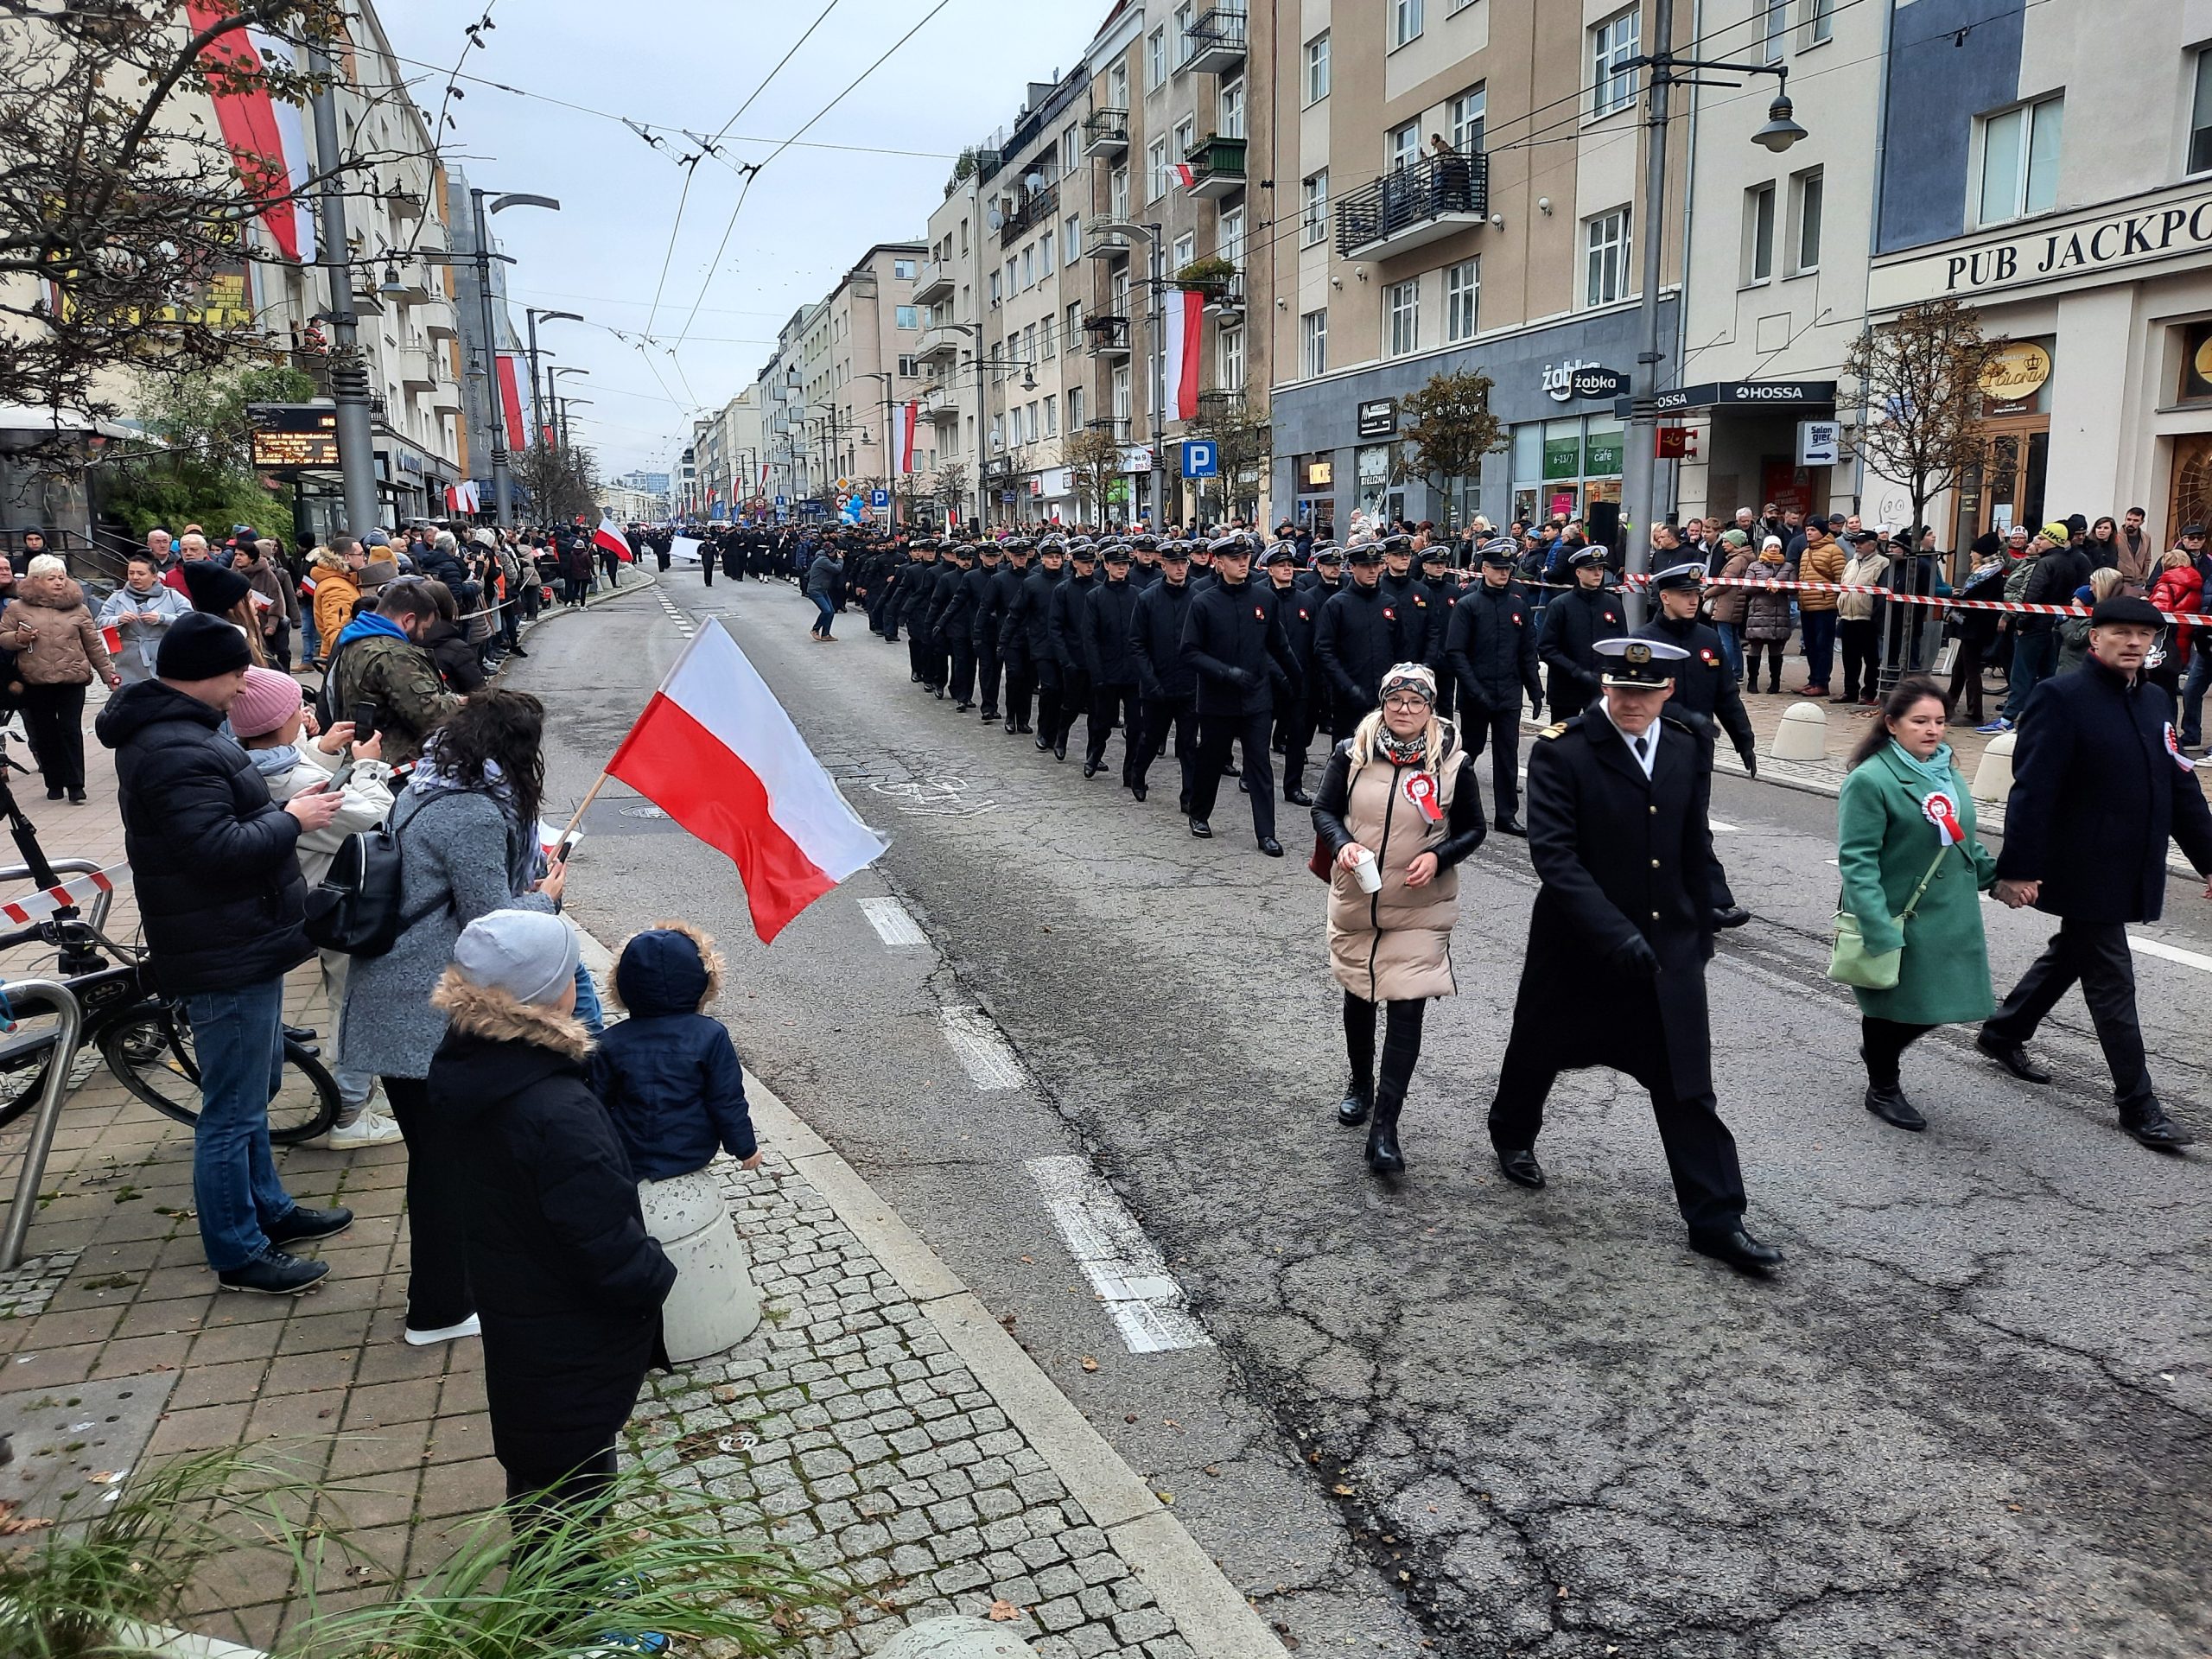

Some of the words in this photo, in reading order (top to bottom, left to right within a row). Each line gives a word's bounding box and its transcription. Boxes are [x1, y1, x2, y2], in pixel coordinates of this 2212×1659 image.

[1946, 246, 2017, 290] PUB
[1575, 374, 1617, 389] żabka
[1750, 386, 1803, 399] HOSSA
[1812, 434, 1831, 444] gier
[1190, 446, 1210, 474] P
[1360, 475, 1386, 486] BIELIZNA
[874, 492, 885, 505] P
